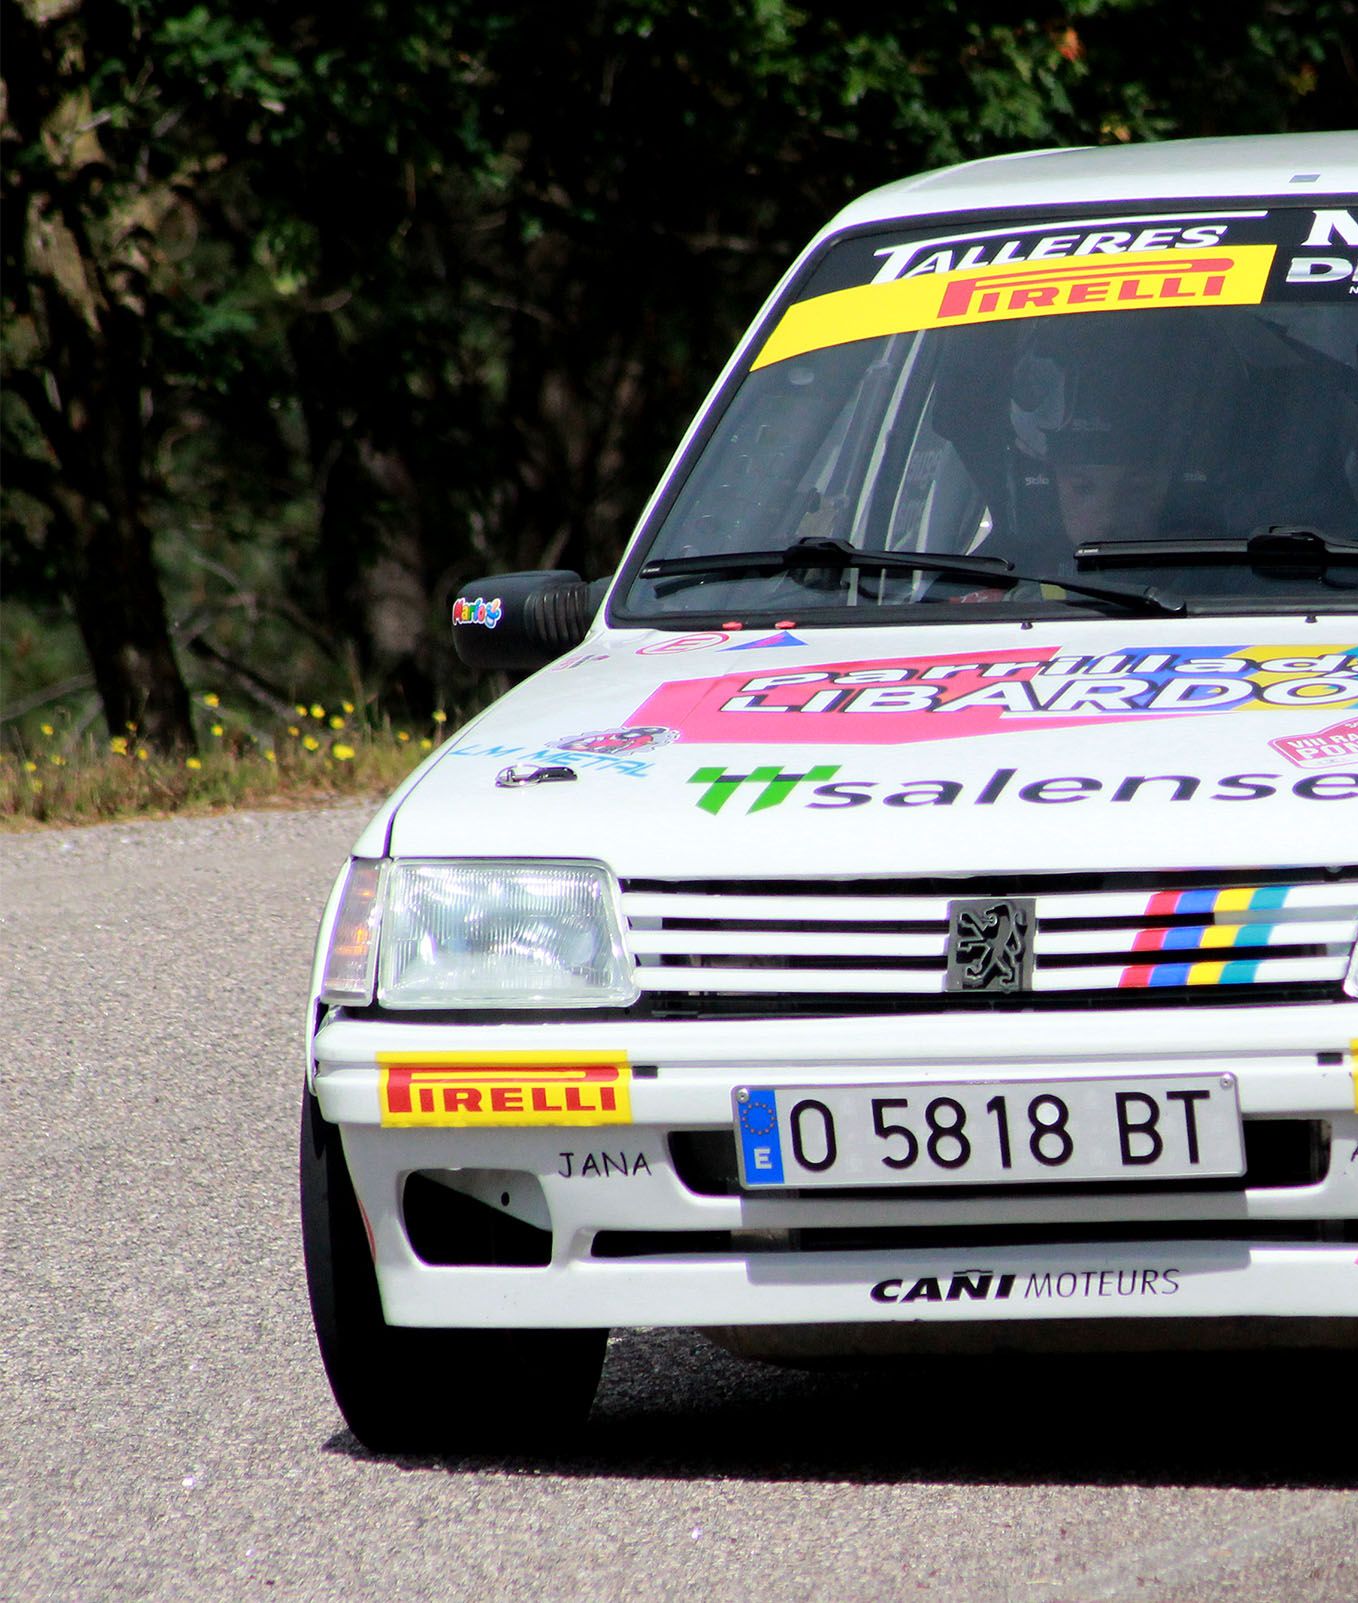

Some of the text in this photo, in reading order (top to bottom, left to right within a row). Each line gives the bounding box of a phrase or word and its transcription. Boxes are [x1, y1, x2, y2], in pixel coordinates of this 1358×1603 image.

[871, 210, 1268, 284] TALLERES
[937, 258, 1234, 318] PIRELLI
[1287, 736, 1328, 750] VIII
[516, 749, 657, 778] METAL
[387, 1066, 620, 1113] PIRELLI
[871, 1093, 1074, 1169] 5818
[1115, 1089, 1211, 1166] BT
[558, 1151, 652, 1178] JANA
[754, 1147, 772, 1169] E
[869, 1268, 1181, 1303] CAÑI MOTEURS
